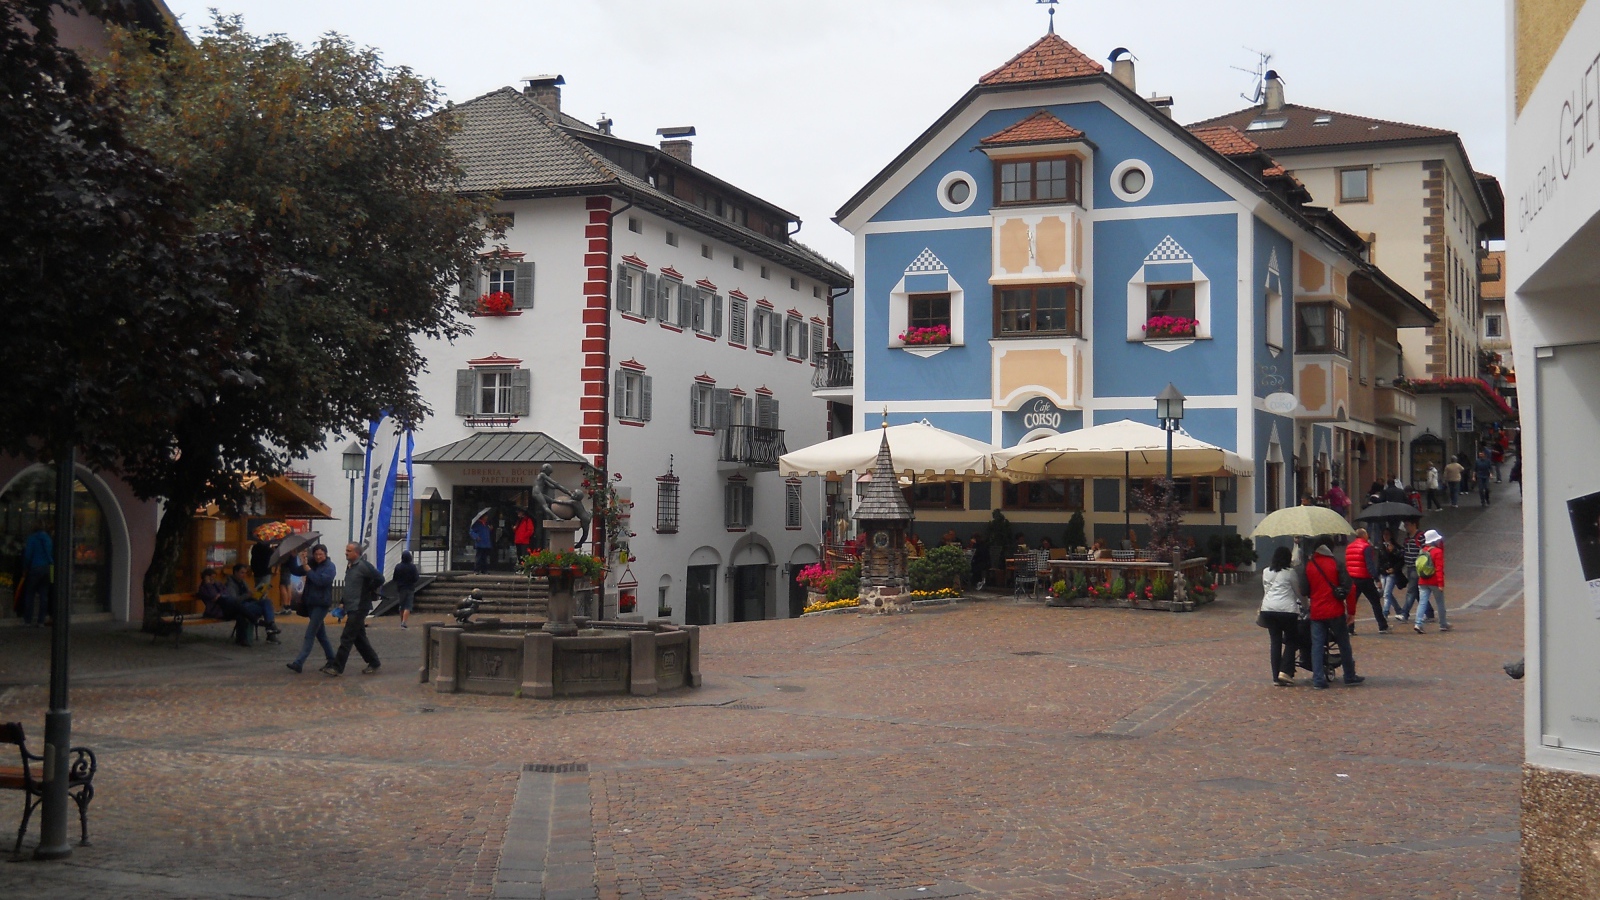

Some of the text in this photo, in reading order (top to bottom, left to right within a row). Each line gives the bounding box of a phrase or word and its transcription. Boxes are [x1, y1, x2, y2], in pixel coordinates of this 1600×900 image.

[1519, 156, 1558, 233] GALLERIA
[1024, 413, 1060, 428] CORSO
[463, 467, 540, 476] LIBRERIA BÜCHE
